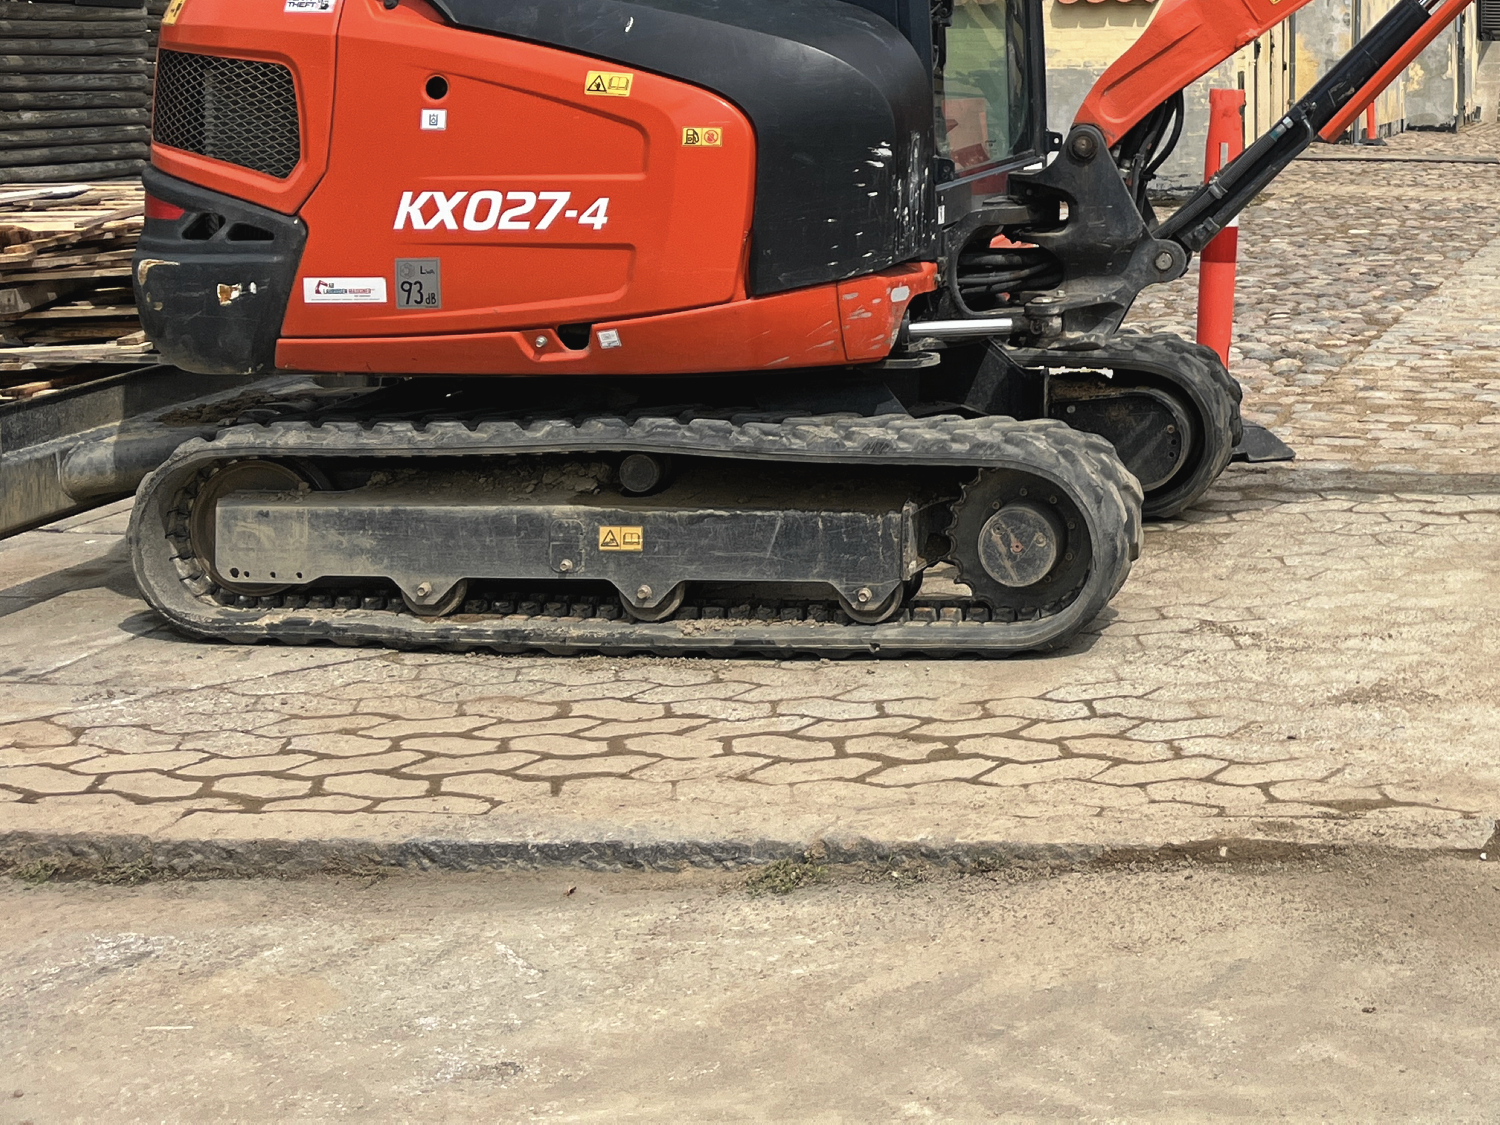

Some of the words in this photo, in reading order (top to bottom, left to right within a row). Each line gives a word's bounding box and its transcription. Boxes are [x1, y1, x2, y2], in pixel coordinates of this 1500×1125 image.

[393, 190, 610, 231] KX027-4
[401, 280, 424, 305] 93
[426, 292, 437, 305] dB
